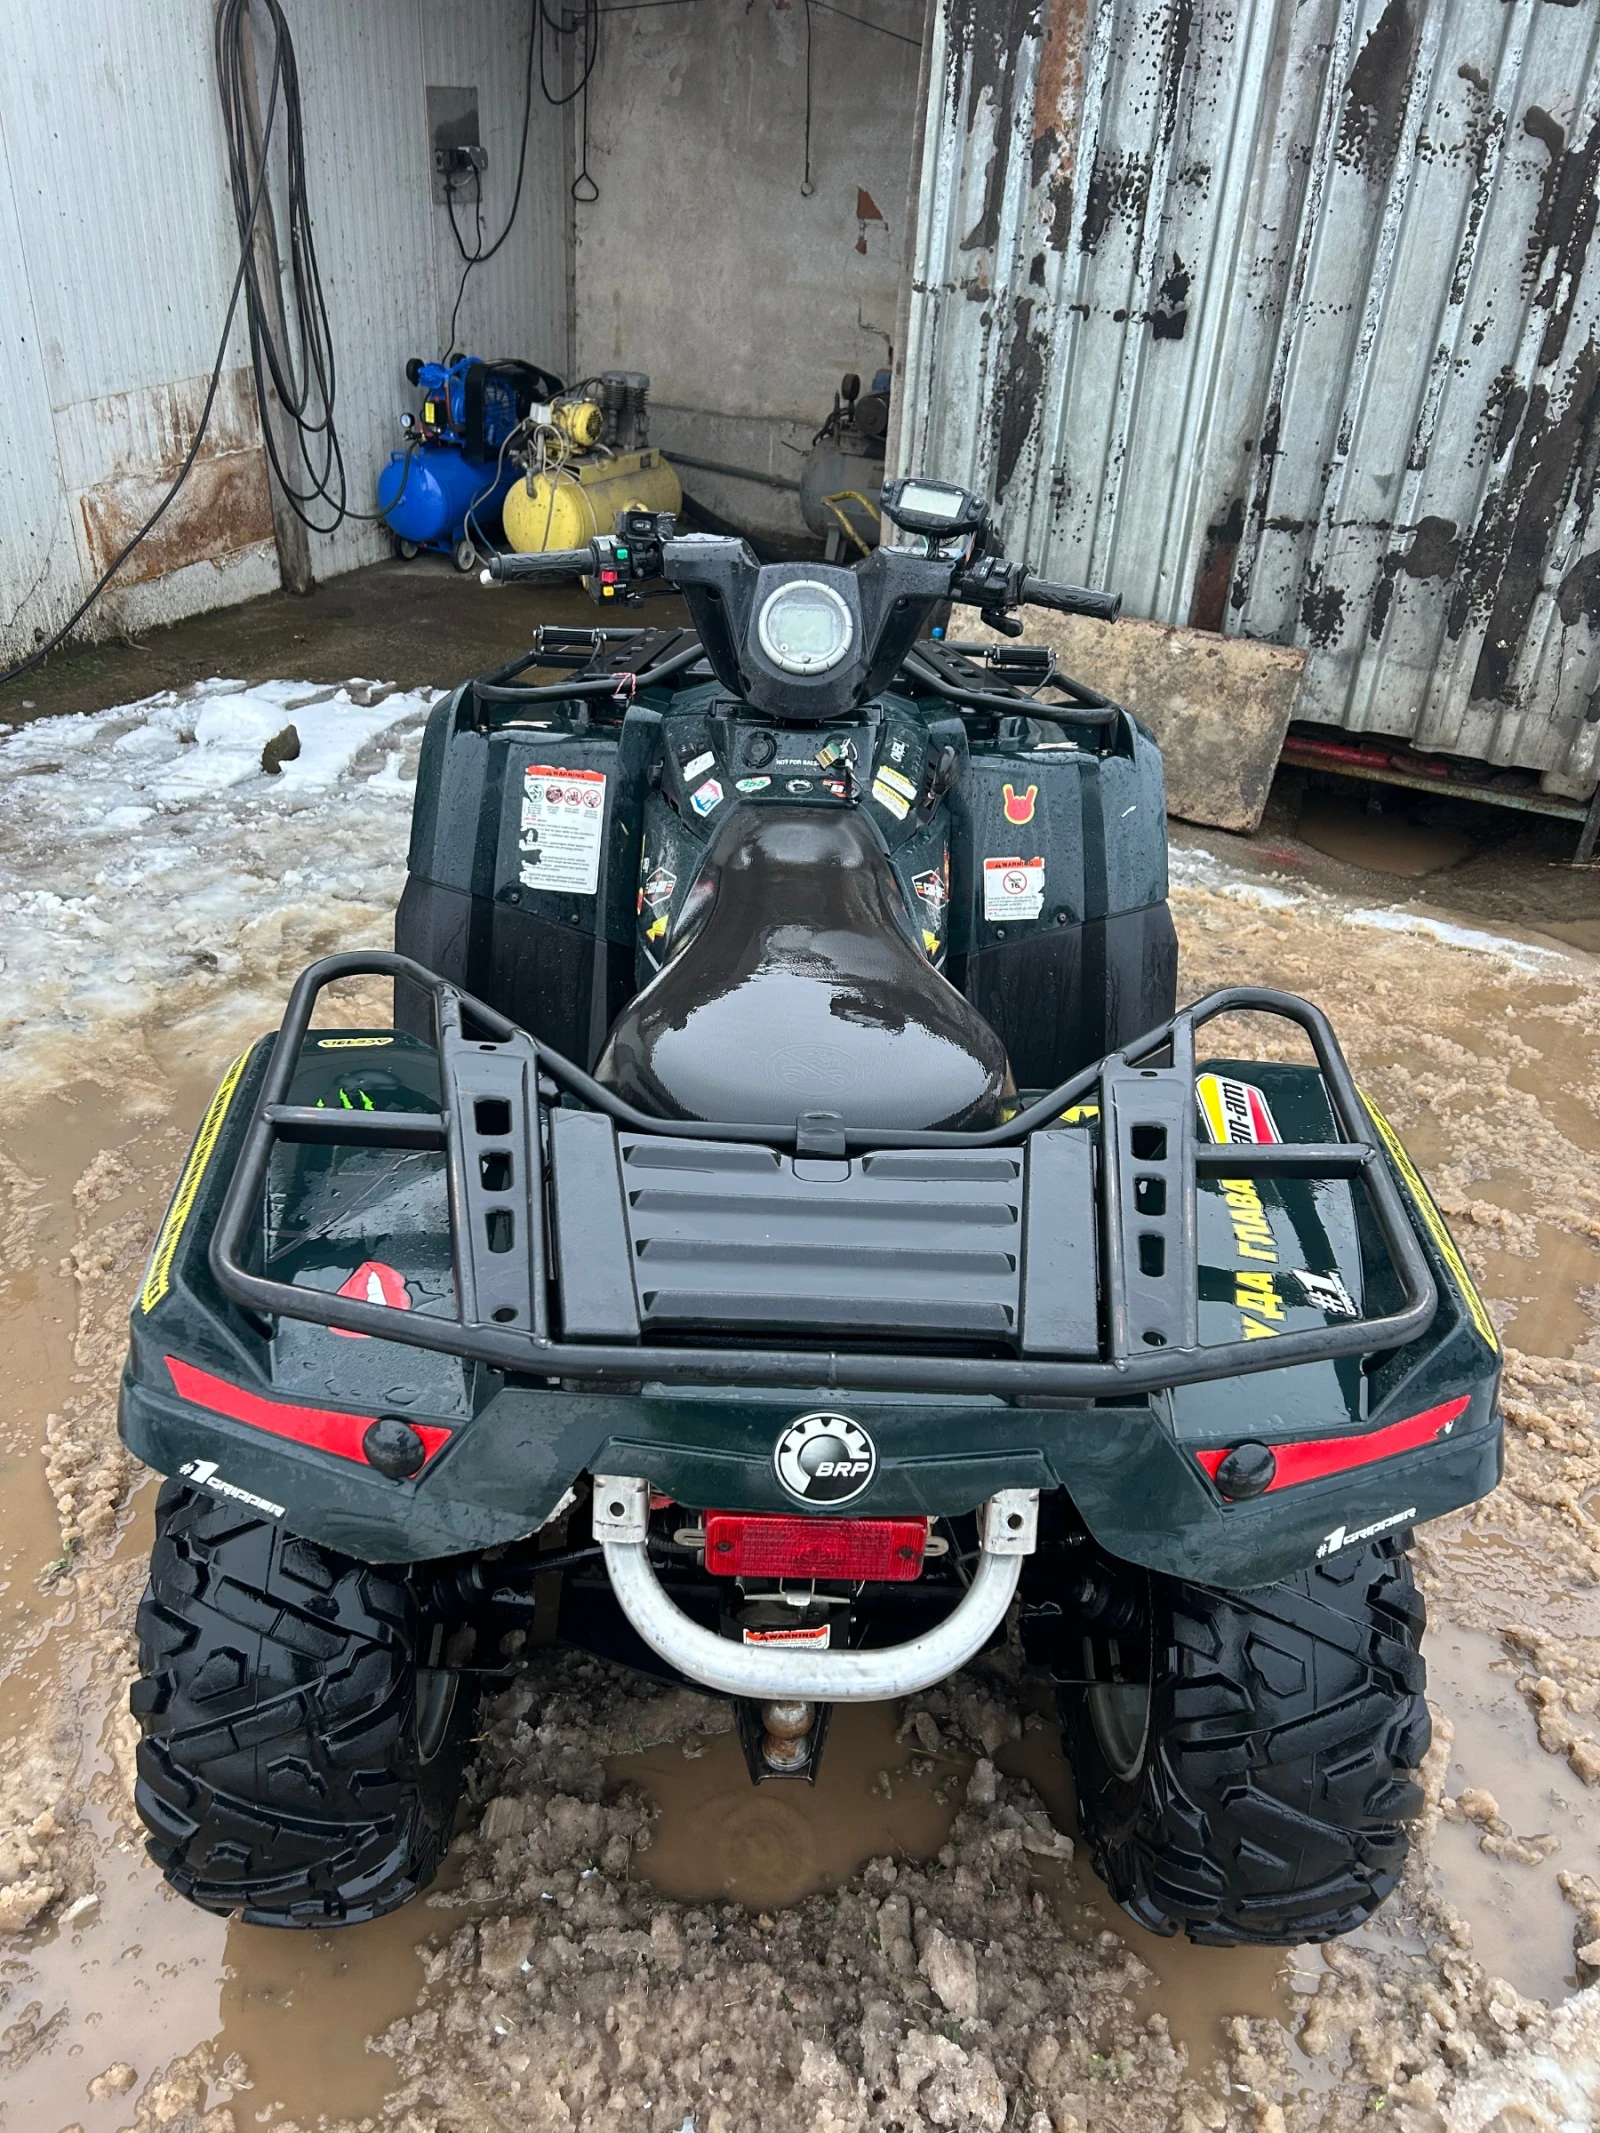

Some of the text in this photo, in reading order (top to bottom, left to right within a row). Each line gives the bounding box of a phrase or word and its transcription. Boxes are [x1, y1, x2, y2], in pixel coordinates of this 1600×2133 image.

[1222, 1082, 1253, 1144] an-am
[179, 1459, 286, 1518] #1 GRIPPER
[815, 1461, 869, 1477] BRP
[1315, 1507, 1417, 1558] #1 GRIPPER
[769, 1632, 816, 1640] WARNING
